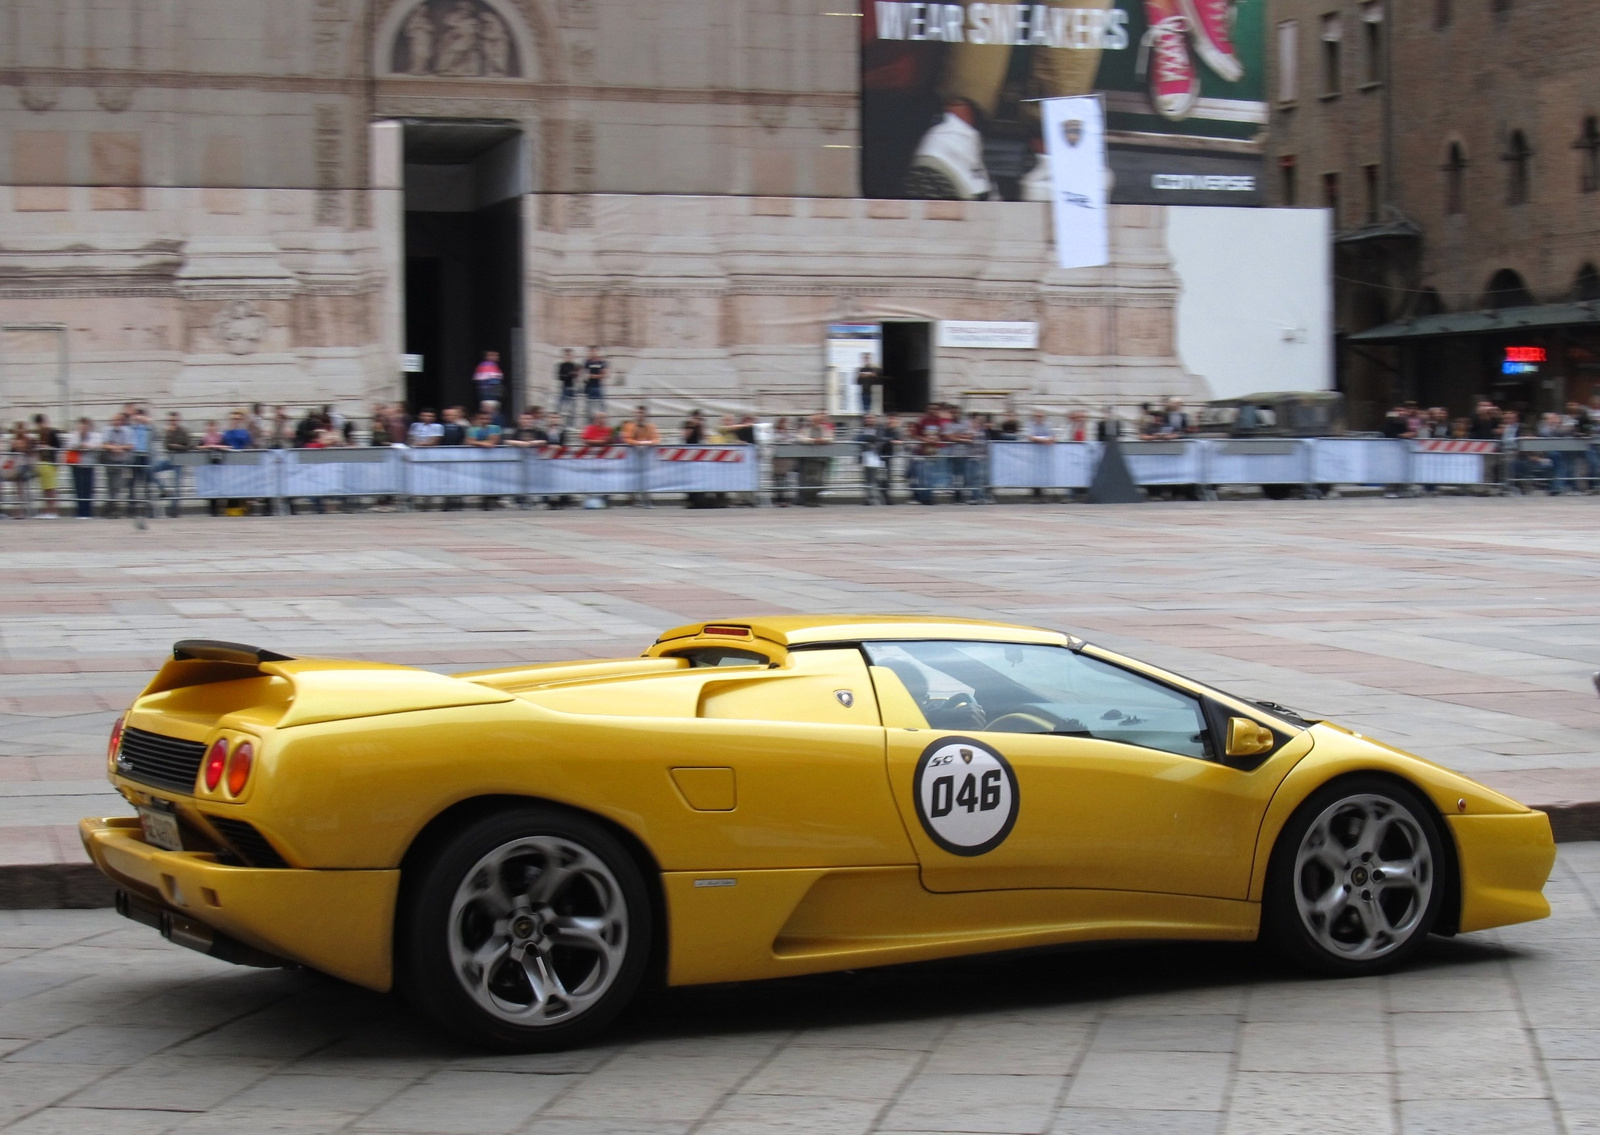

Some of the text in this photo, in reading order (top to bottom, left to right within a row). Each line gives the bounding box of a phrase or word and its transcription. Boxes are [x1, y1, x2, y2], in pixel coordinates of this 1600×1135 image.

[875, 1, 1129, 50] WEAR SNEAKERS
[930, 769, 1002, 818] 046
